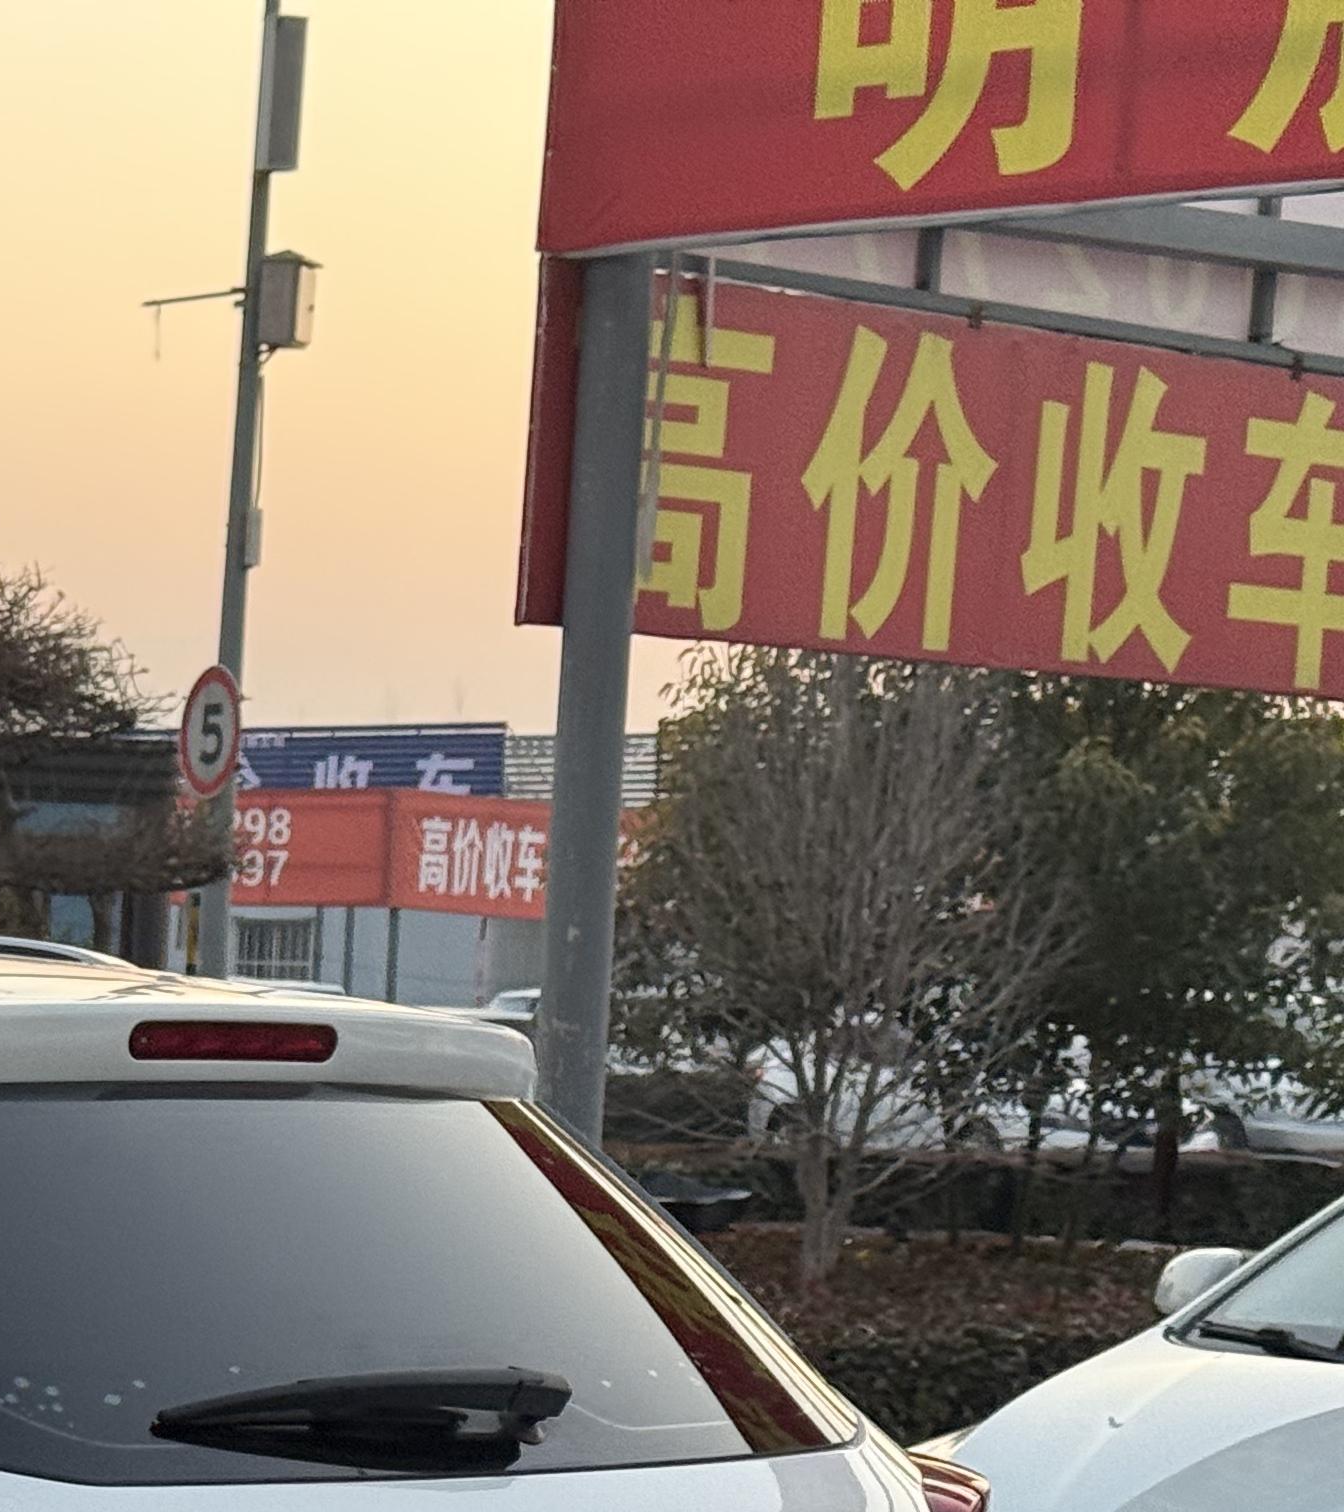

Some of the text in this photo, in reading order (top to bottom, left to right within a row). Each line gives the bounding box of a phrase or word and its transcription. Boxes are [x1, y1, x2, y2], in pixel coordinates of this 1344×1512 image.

[634, 292, 1344, 691] 高价收车
[200, 703, 225, 765] 5
[418, 816, 546, 903] 高价收车
